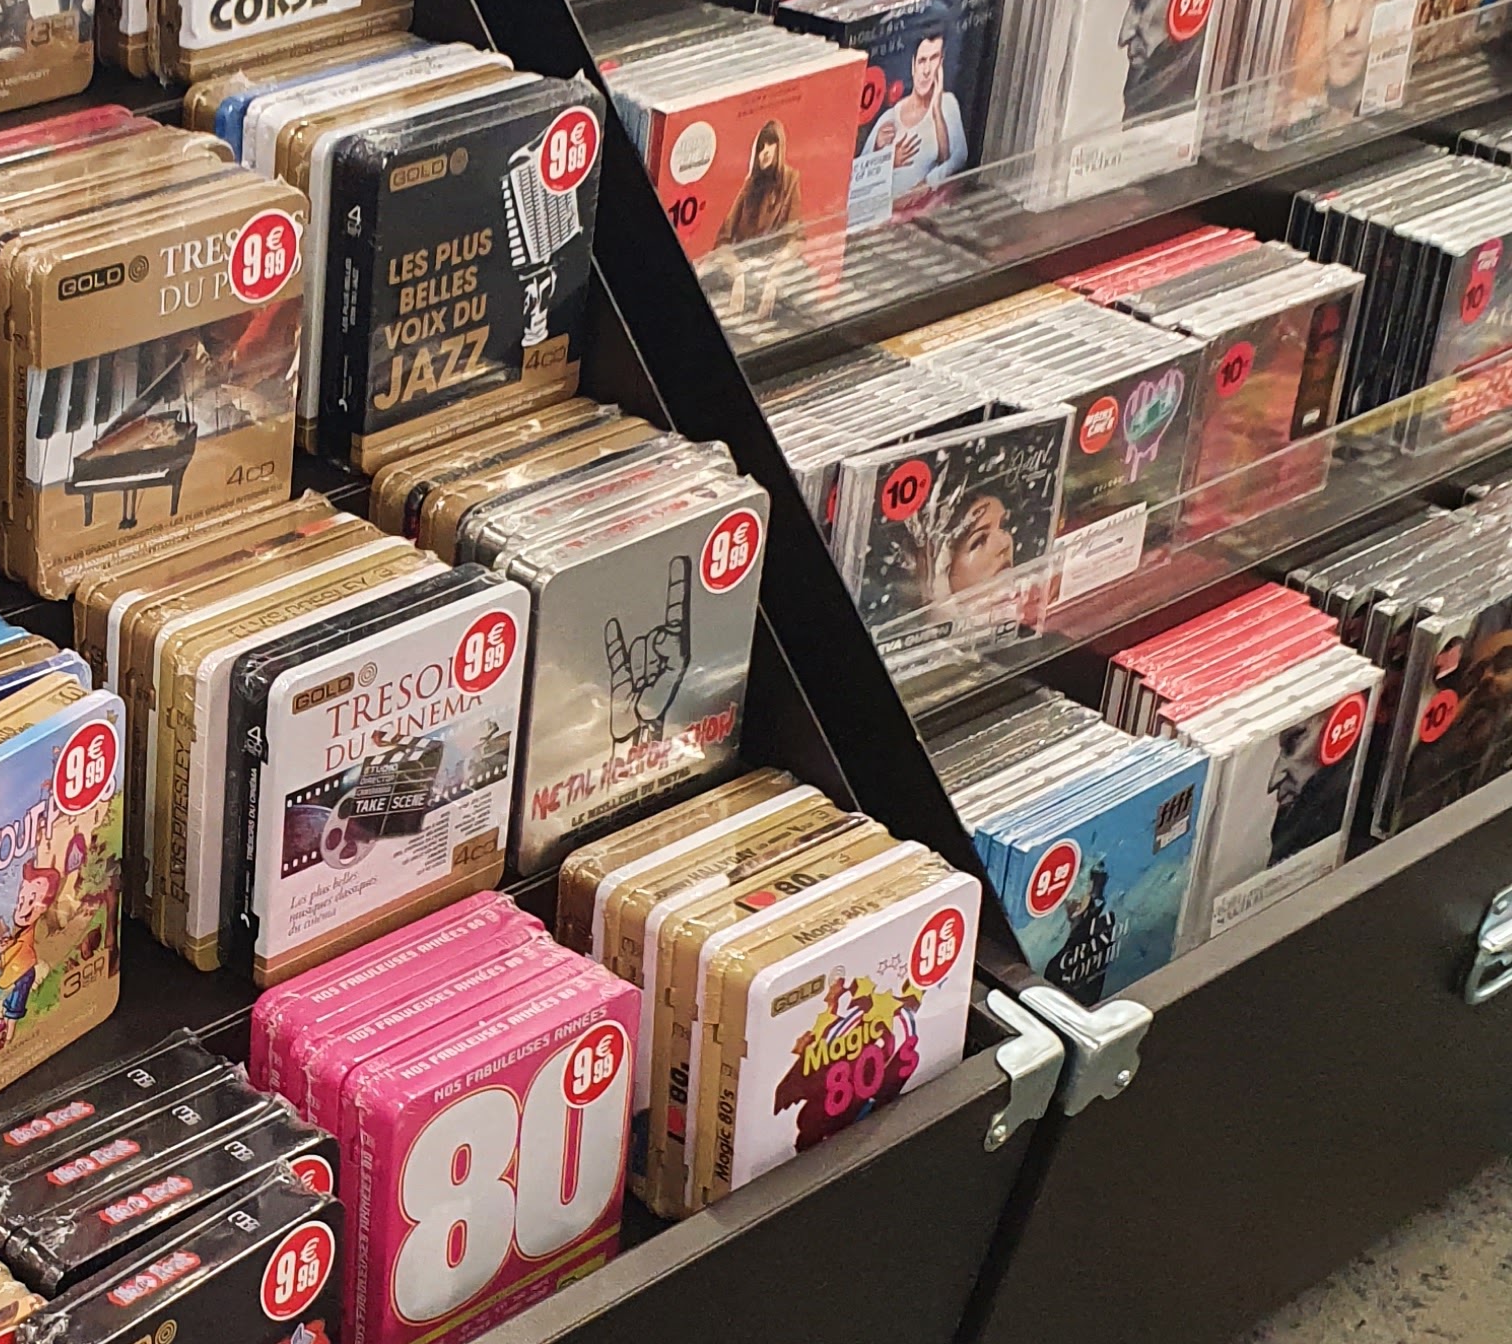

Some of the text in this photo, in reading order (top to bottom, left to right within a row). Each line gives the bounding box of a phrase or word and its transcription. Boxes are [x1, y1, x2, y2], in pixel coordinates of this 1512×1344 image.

[392, 158, 446, 188] GOLD
[60, 264, 125, 298] GOLD
[388, 227, 494, 286] LES PLUS
[159, 276, 205, 317] DU
[399, 265, 479, 315] BELLES
[384, 292, 488, 351] VOIX DU
[373, 324, 490, 411] JAZZ
[294, 675, 352, 713] GOLD
[323, 733, 365, 774] DU
[354, 792, 428, 814] TAKE SCENE
[530, 766, 596, 824] METAL
[310, 988, 339, 1004] NOS
[339, 949, 418, 992] FABULEUSES
[771, 976, 826, 1016] GOLD
[346, 1028, 375, 1045] NOS
[376, 986, 454, 1032] FABULEUSES
[401, 1064, 427, 1081] NOS
[428, 1020, 508, 1068] FABULEUSES
[433, 1005, 609, 1104] NOS FABULEUSES ANNÉES
[802, 1014, 884, 1076] Magic
[389, 1035, 630, 1327] 80
